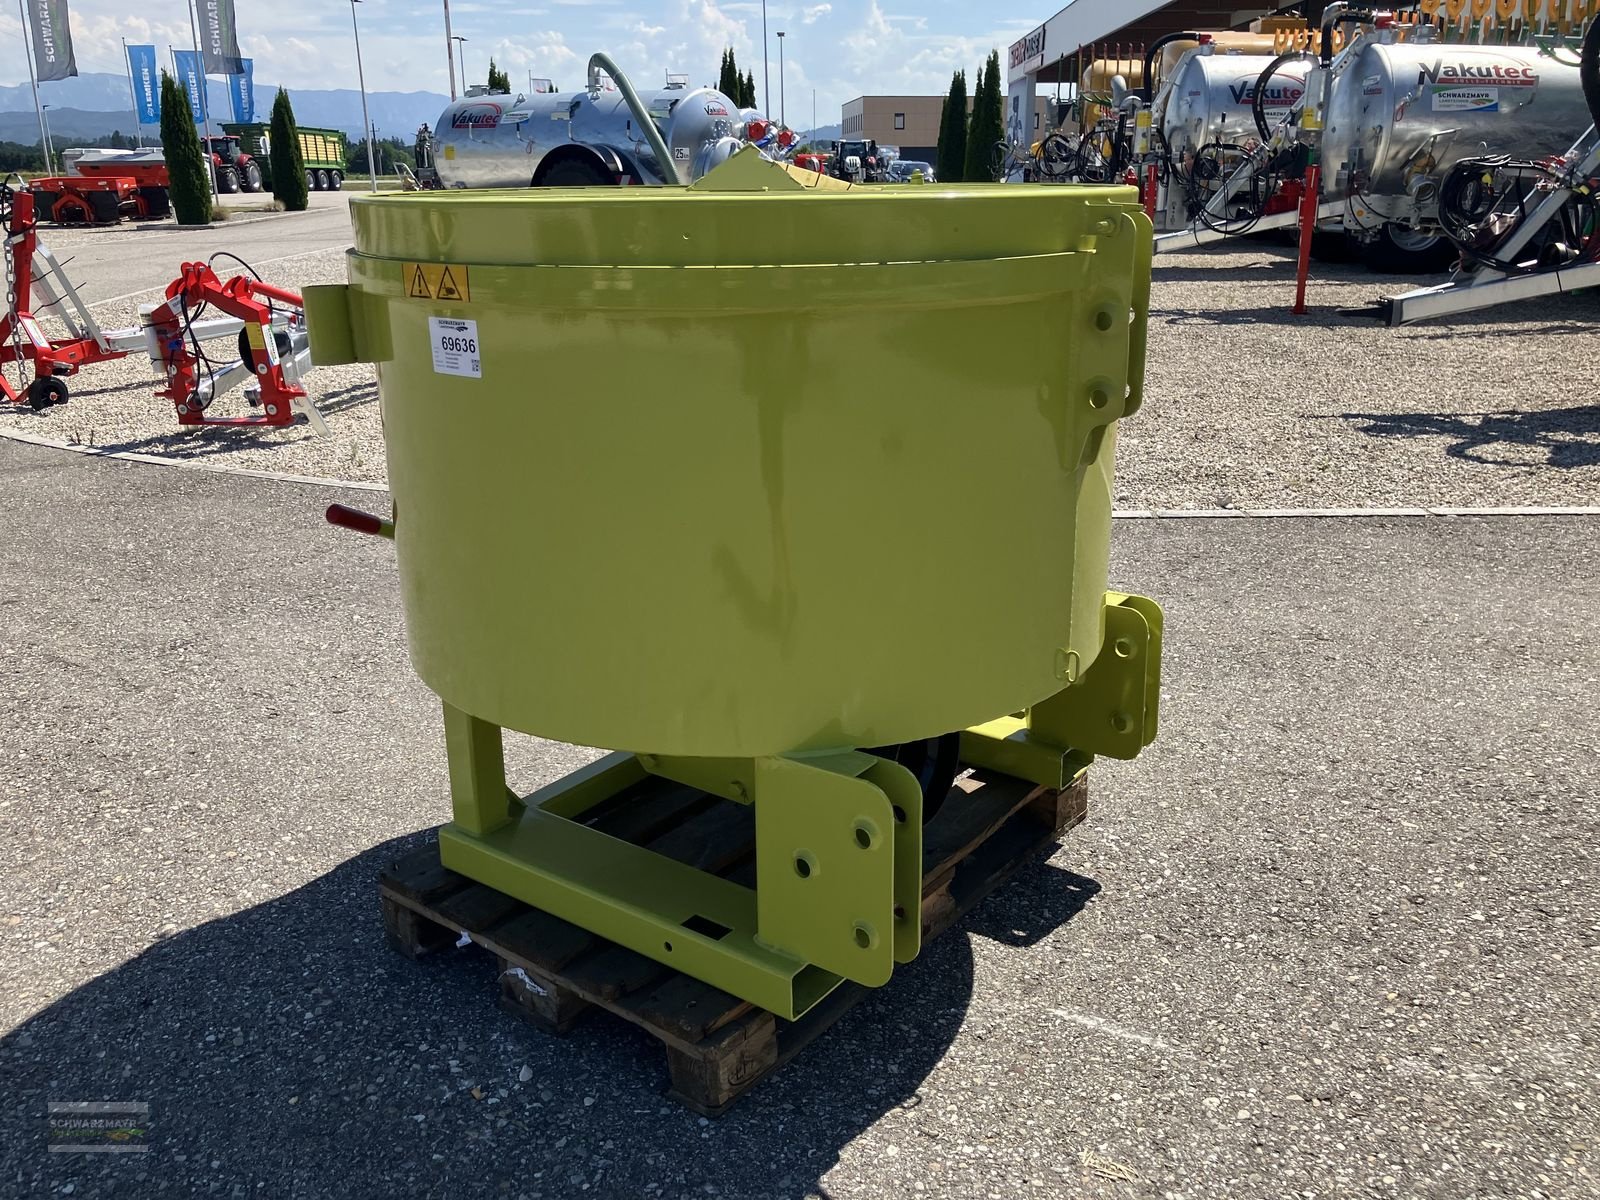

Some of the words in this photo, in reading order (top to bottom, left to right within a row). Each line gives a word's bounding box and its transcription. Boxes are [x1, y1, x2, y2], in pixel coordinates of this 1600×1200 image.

[39, 0, 55, 63] SCHWARZ
[207, 0, 222, 55] SCHWAR
[1418, 58, 1535, 84] Vakutec
[141, 67, 153, 107] LEMKEN
[188, 71, 200, 109] LEMKEN
[240, 77, 250, 112] LEMKEN
[1229, 80, 1305, 105] Vakute
[451, 109, 500, 129] Vakutec
[675, 148, 684, 159] 25
[441, 335, 476, 354] 69636
